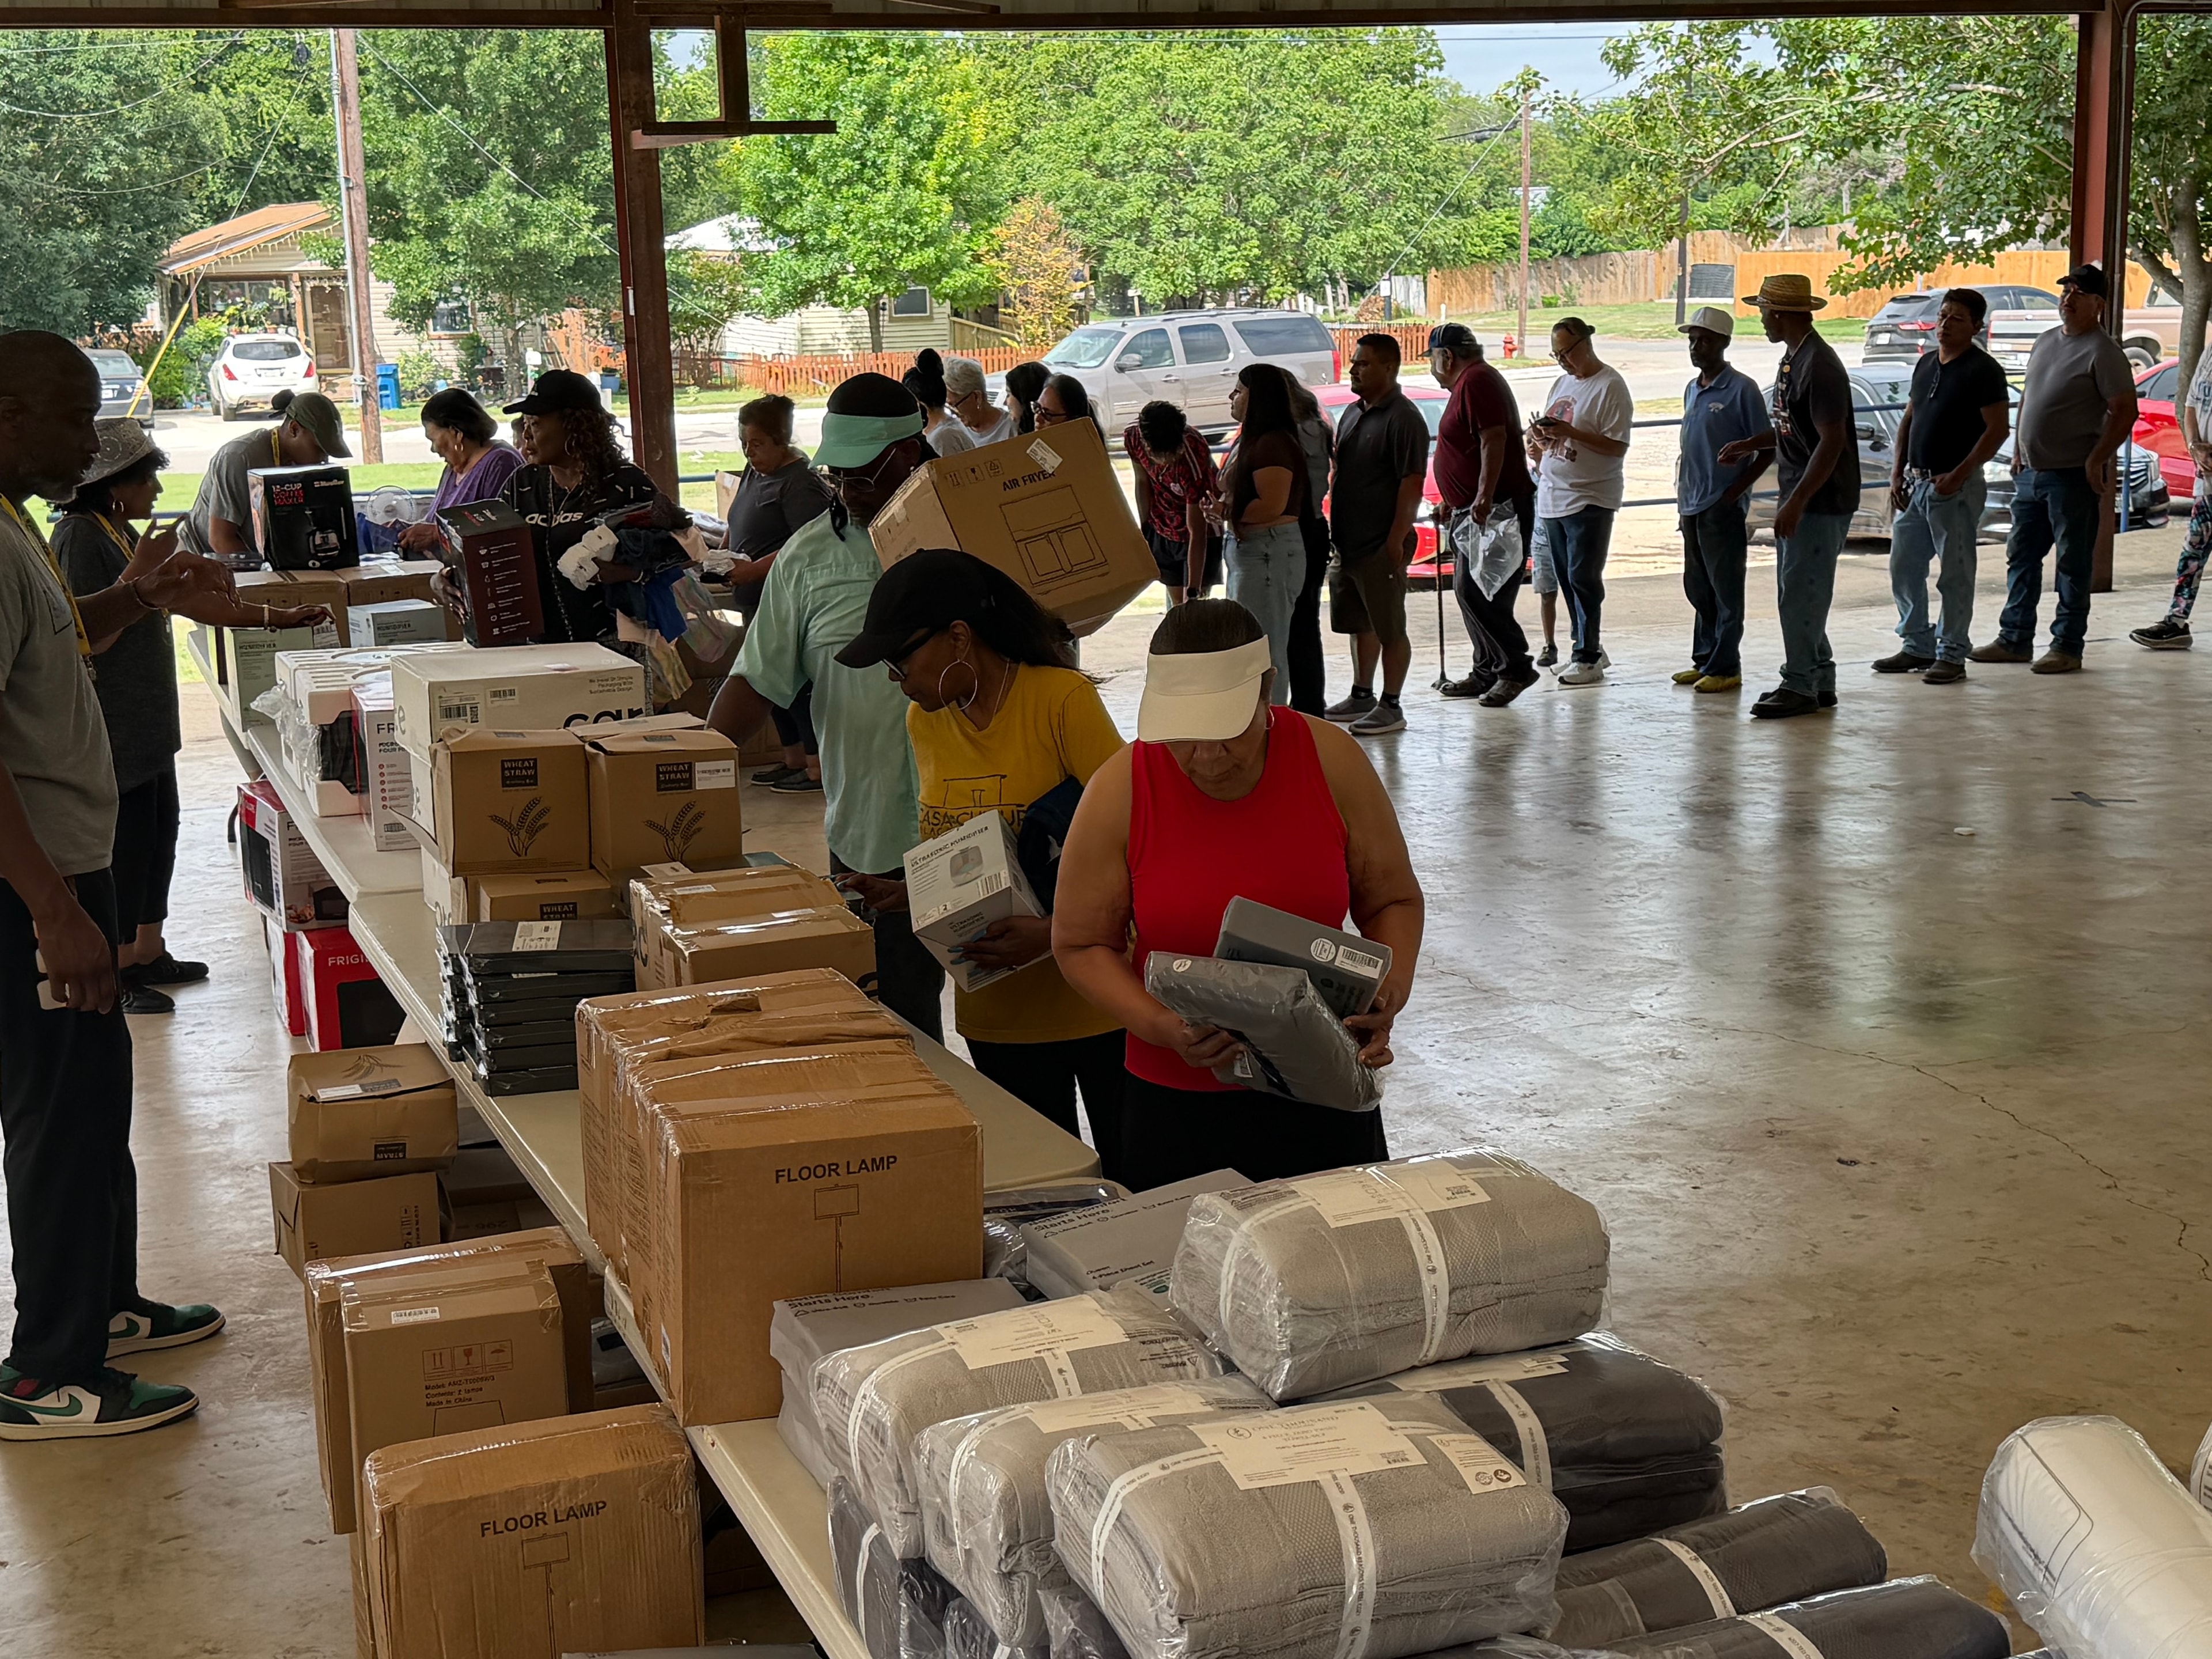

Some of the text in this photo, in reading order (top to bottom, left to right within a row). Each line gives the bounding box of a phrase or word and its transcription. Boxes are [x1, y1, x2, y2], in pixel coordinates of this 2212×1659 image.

[1003, 469, 1056, 491] AIR FRYER
[272, 483, 302, 492] 12-CUP
[503, 760, 535, 768] WHEAT
[658, 764, 689, 772] WHEAT
[659, 772, 690, 781] STRAW
[920, 808, 953, 826] ASA
[543, 904, 573, 912] WHEAT
[328, 954, 369, 967] FRIGI
[775, 1155, 897, 1184] FLOOR LAMP
[1034, 1218, 1075, 1232] Starts
[788, 1298, 831, 1309] Starts
[480, 1500, 607, 1537] FLOOR LAMP
